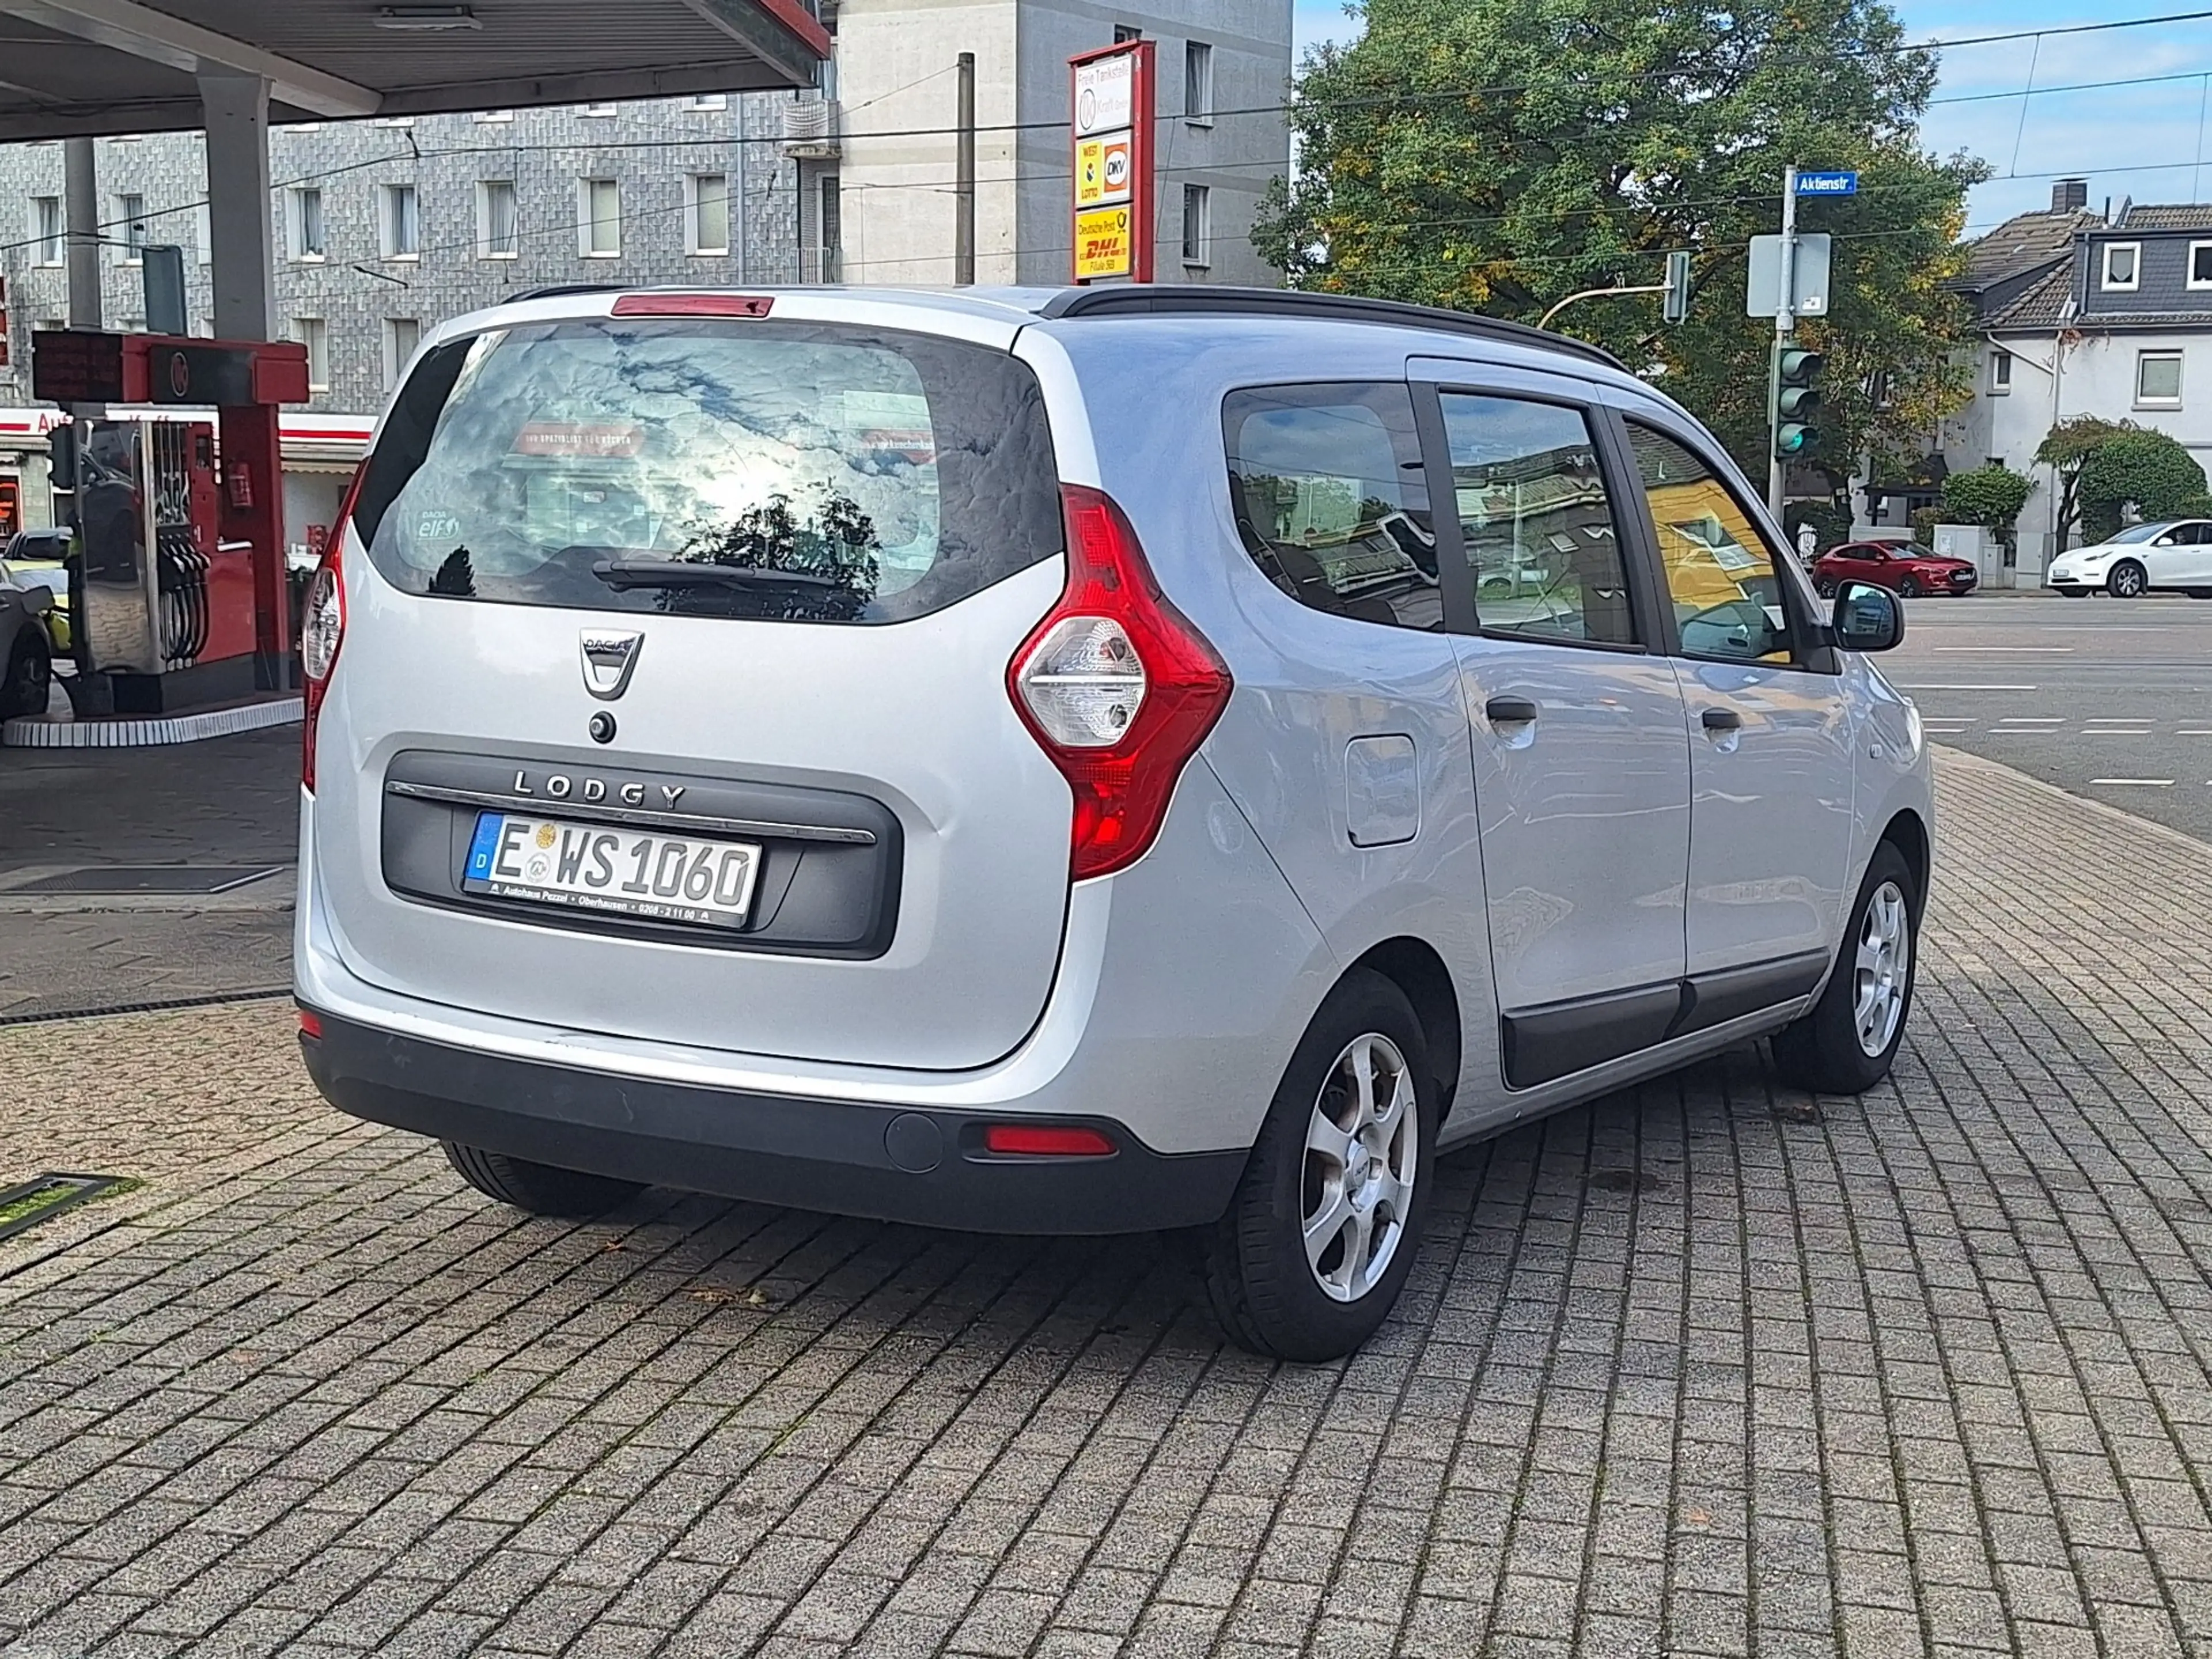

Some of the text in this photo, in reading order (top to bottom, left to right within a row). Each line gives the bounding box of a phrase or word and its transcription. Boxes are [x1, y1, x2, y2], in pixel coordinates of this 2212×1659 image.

[1078, 62, 1129, 86] Freie Tankstelle
[1083, 145, 1097, 157] WEST
[1107, 159, 1126, 176] DKV
[1081, 187, 1098, 199] LOTTO
[1078, 221, 1115, 235] Deutsche Post
[1086, 237, 1120, 259] DHL
[419, 519, 446, 537] elf
[586, 639, 628, 653] DACIA
[513, 770, 685, 810] LODGY
[495, 822, 531, 877] E
[475, 853, 487, 869] D
[503, 885, 541, 899] Autohaus
[578, 896, 628, 911] Oberhausen
